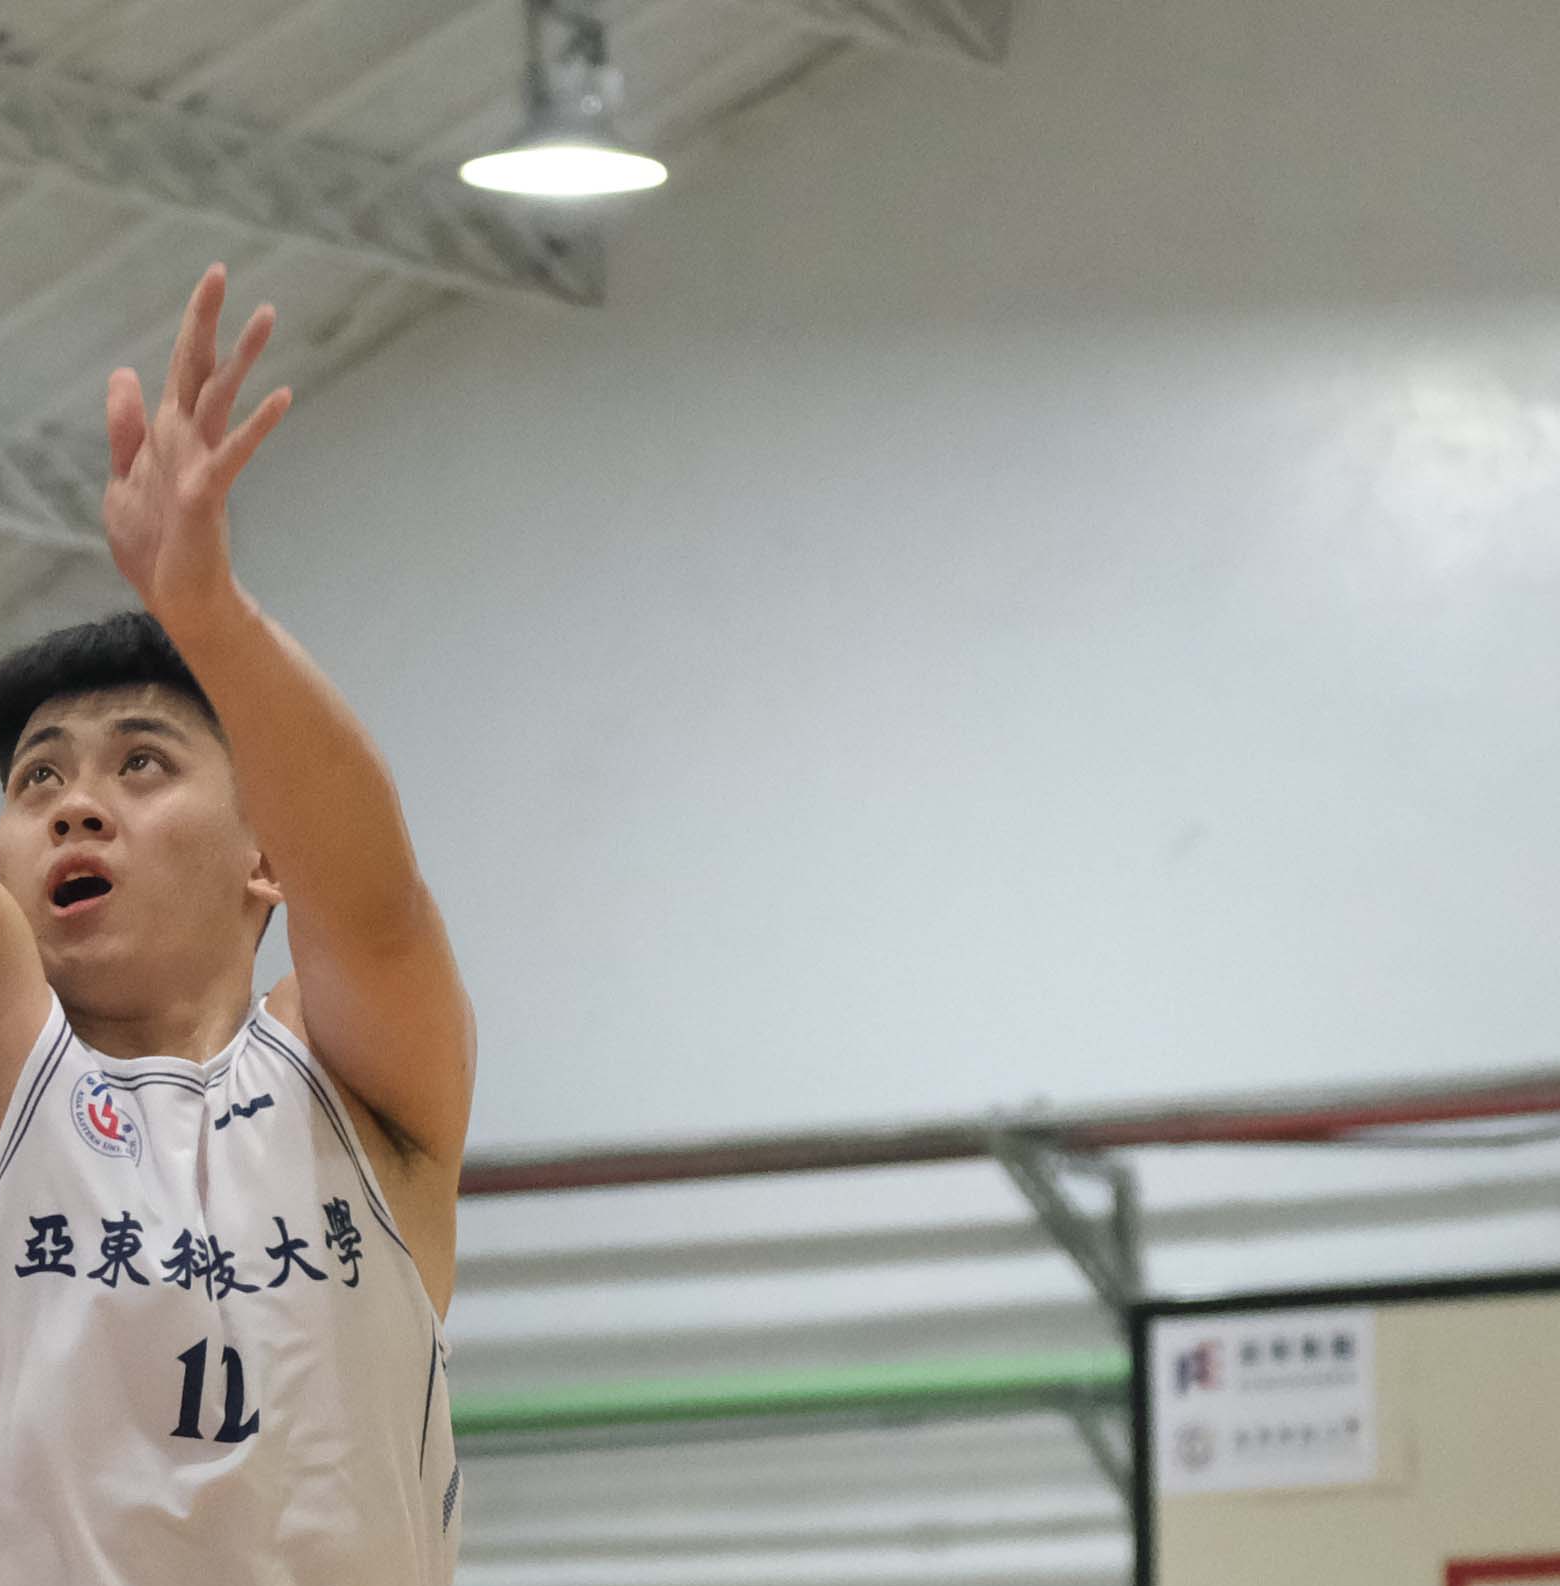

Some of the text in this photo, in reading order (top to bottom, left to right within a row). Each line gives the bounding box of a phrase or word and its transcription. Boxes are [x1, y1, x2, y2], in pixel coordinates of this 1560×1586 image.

[14, 1197, 364, 1300] 亞東科技大學
